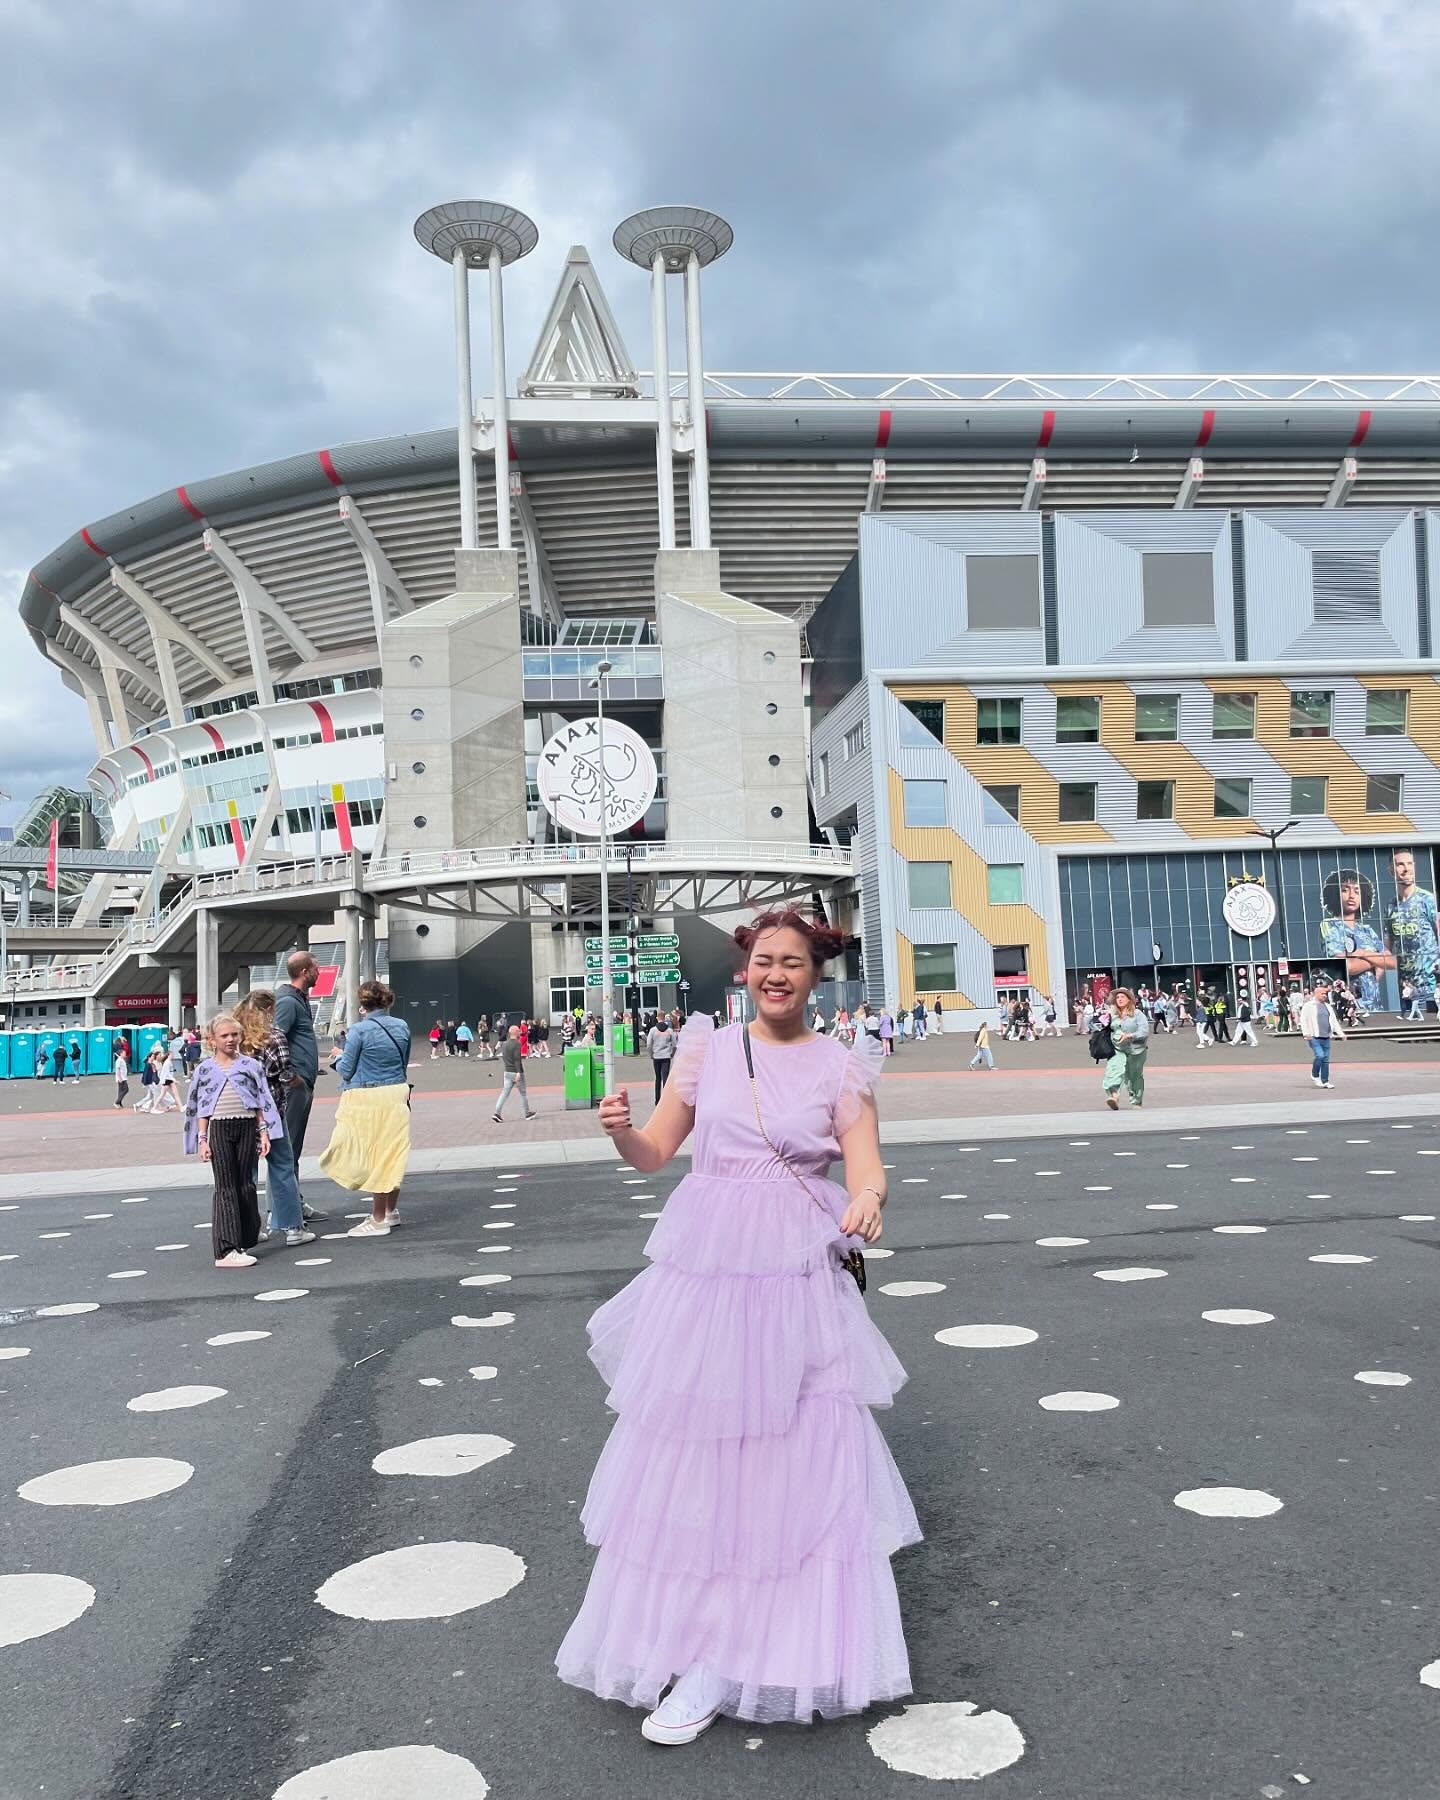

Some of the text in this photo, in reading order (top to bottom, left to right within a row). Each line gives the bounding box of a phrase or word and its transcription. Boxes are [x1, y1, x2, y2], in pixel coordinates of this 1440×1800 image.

[544, 721, 599, 767] AJAX
[606, 790, 649, 830] MSTERDAM
[1227, 886, 1247, 908] AJAX
[153, 998, 168, 1006] KAS
